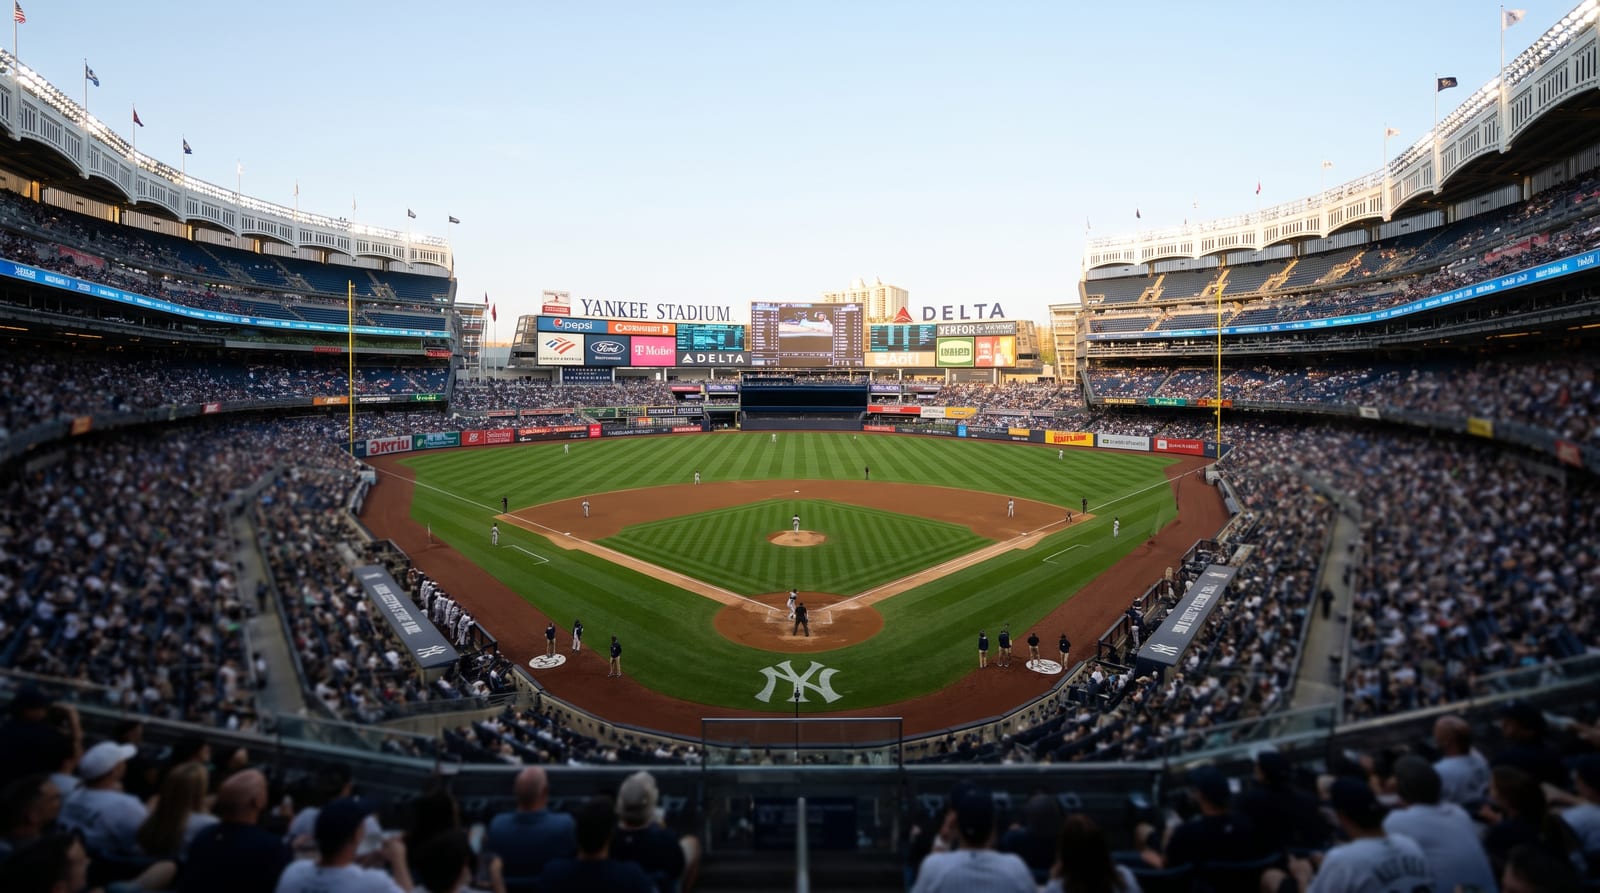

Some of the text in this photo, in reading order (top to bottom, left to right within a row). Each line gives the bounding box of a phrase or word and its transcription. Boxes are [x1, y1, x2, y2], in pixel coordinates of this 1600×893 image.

[581, 298, 730, 322] YANKEE STADIUM
[922, 302, 1005, 321] DELTA
[564, 321, 593, 331] pepsi
[697, 353, 745, 364] DELTA
[754, 660, 843, 703] NY
